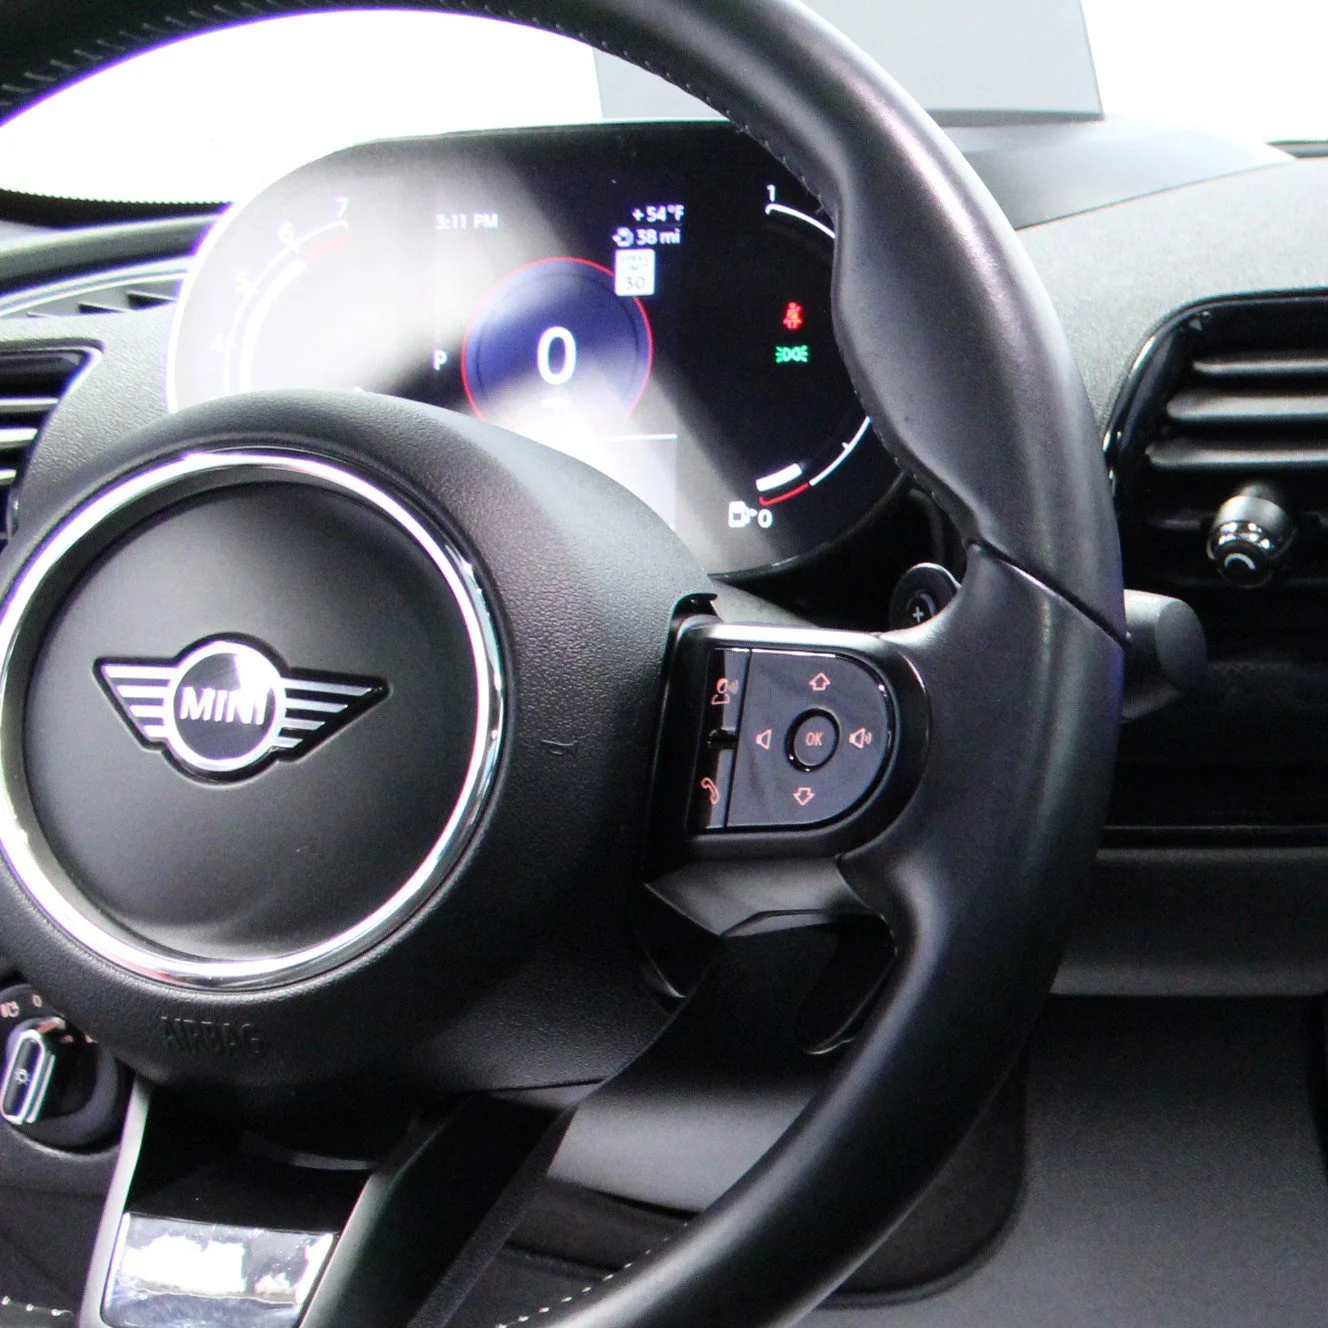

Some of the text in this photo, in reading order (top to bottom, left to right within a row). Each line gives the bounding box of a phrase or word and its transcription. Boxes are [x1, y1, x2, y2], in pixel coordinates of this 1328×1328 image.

[766, 184, 776, 202] 1
[335, 197, 349, 218] 7
[436, 212, 498, 230] 3:11 PM
[636, 227, 681, 245] 38 mi
[625, 276, 646, 290] 30
[432, 350, 447, 371] P
[536, 325, 578, 386] 0
[757, 508, 773, 528] 0
[179, 686, 267, 724] MINI
[805, 732, 824, 746] OK
